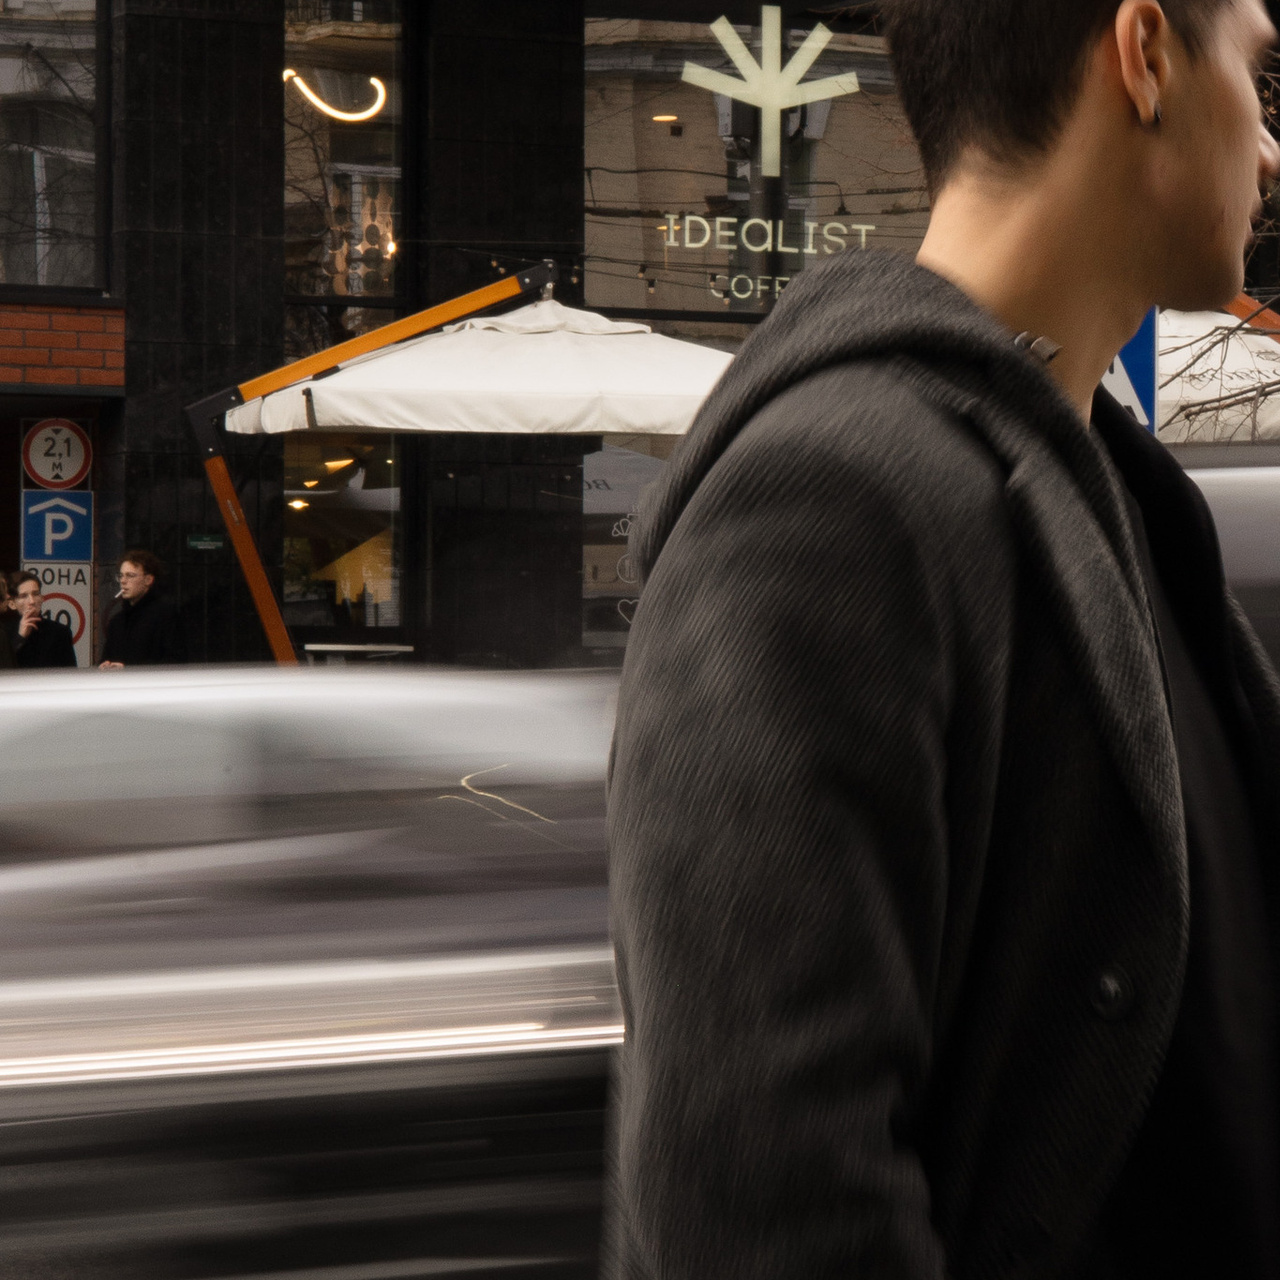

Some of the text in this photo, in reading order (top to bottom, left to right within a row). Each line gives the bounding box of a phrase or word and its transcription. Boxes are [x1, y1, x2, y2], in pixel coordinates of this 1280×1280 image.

[710, 274, 791, 300] COFF
[43, 436, 71, 460] 2,1
[44, 512, 74, 556] P
